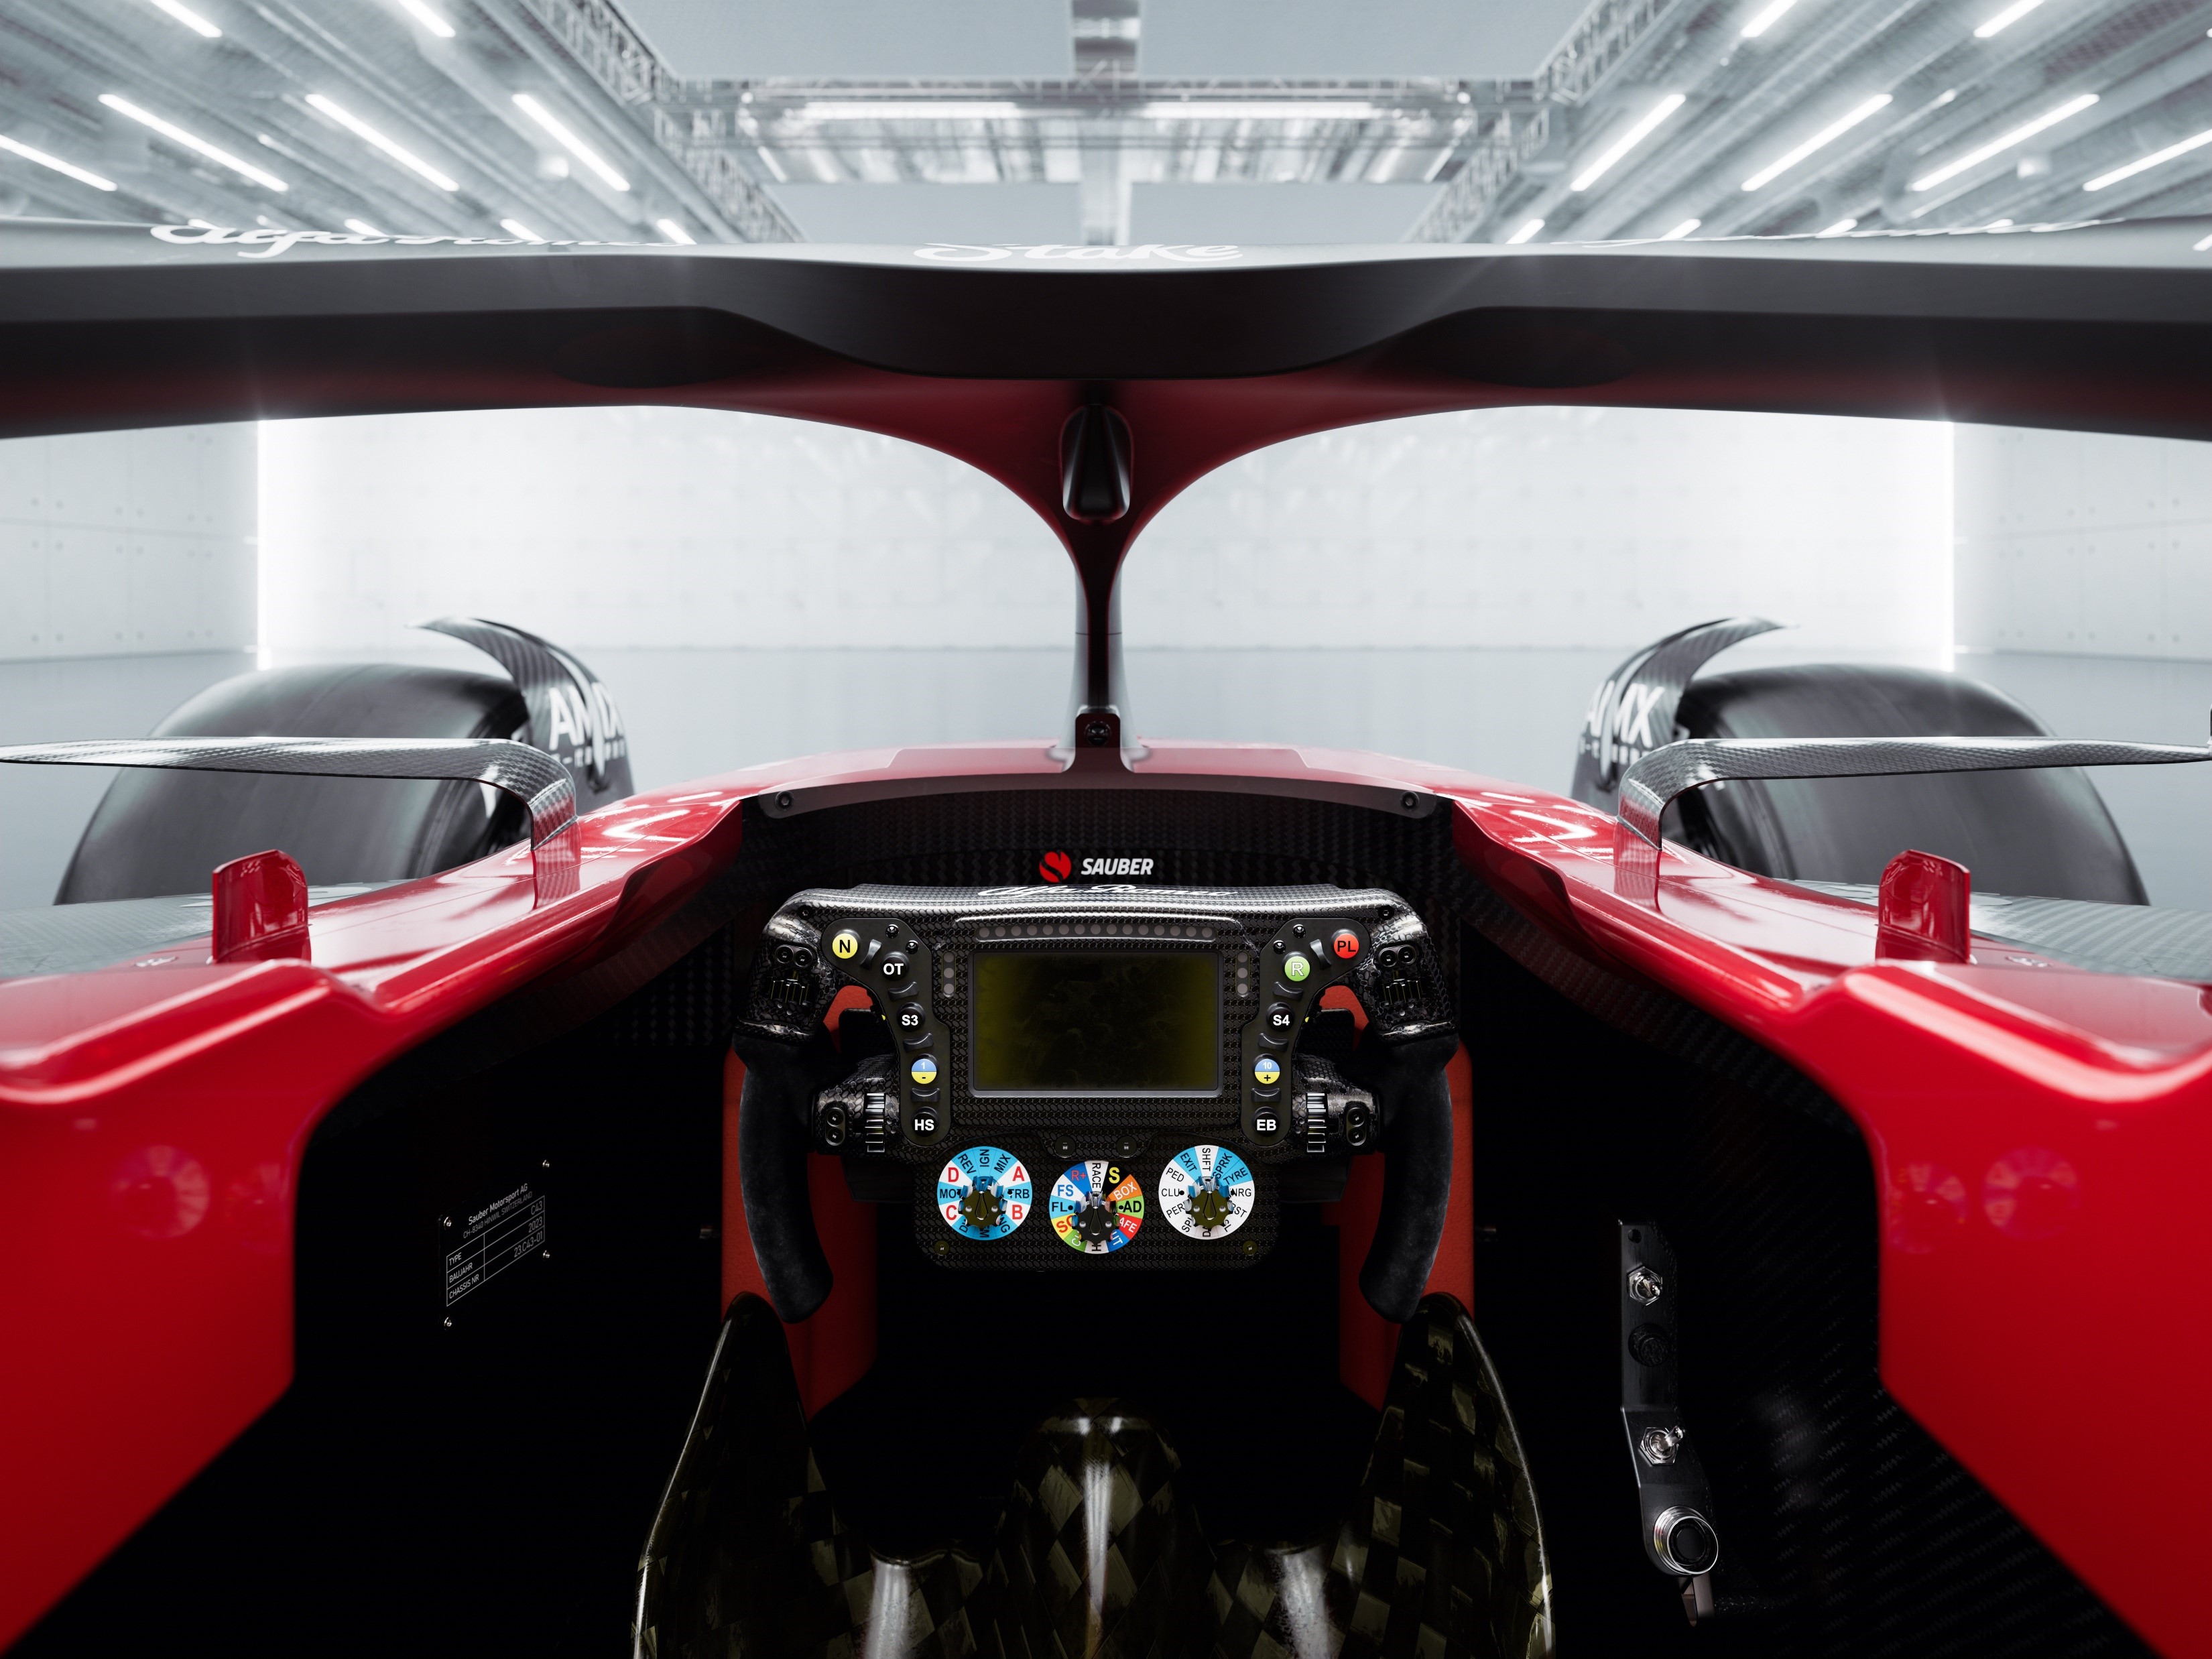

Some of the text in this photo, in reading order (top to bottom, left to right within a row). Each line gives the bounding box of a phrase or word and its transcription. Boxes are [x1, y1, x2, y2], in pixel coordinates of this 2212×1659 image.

[914, 243, 1243, 262] Stake
[1081, 857, 1154, 875] SAUBER
[977, 884, 1238, 898] Alfa Romeo
[839, 940, 851, 953] N
[1337, 940, 1356, 953] PL
[883, 963, 904, 975] OT
[1291, 961, 1304, 977] R
[902, 1015, 918, 1026] S3
[1273, 1015, 1290, 1026] S4
[1263, 1062, 1272, 1070] 10
[914, 1119, 934, 1131] HS
[1257, 1119, 1276, 1131] EB
[958, 1154, 977, 1174] REV
[980, 1149, 989, 1167] IGN
[993, 1154, 1011, 1173] MIX
[1180, 1152, 1197, 1172] EXIT
[1203, 1148, 1211, 1171] SHFT
[1213, 1152, 1232, 1179] SPRK
[948, 1167, 959, 1182] D
[1013, 1166, 1025, 1181] A
[1092, 1163, 1101, 1188] RACE
[1109, 1167, 1120, 1184] S
[1166, 1168, 1184, 1182] PED
[1223, 1168, 1248, 1184] TYRE
[1058, 1184, 1074, 1196] FS
[1113, 1181, 1137, 1200] BOX
[469, 1183, 528, 1225] Sauber Motorsport AG
[484, 1212, 501, 1229] HINWIL
[501, 1191, 533, 1218] SWITZERLAND
[1012, 1205, 1023, 1219] B
[1123, 1201, 1142, 1213] AD
[946, 1205, 957, 1221] C
[449, 1200, 543, 1266] TYPE C43
[449, 1217, 543, 1283] BAUJAHR 2023
[449, 1230, 543, 1299] CHASSIS NR 23.C43-01
